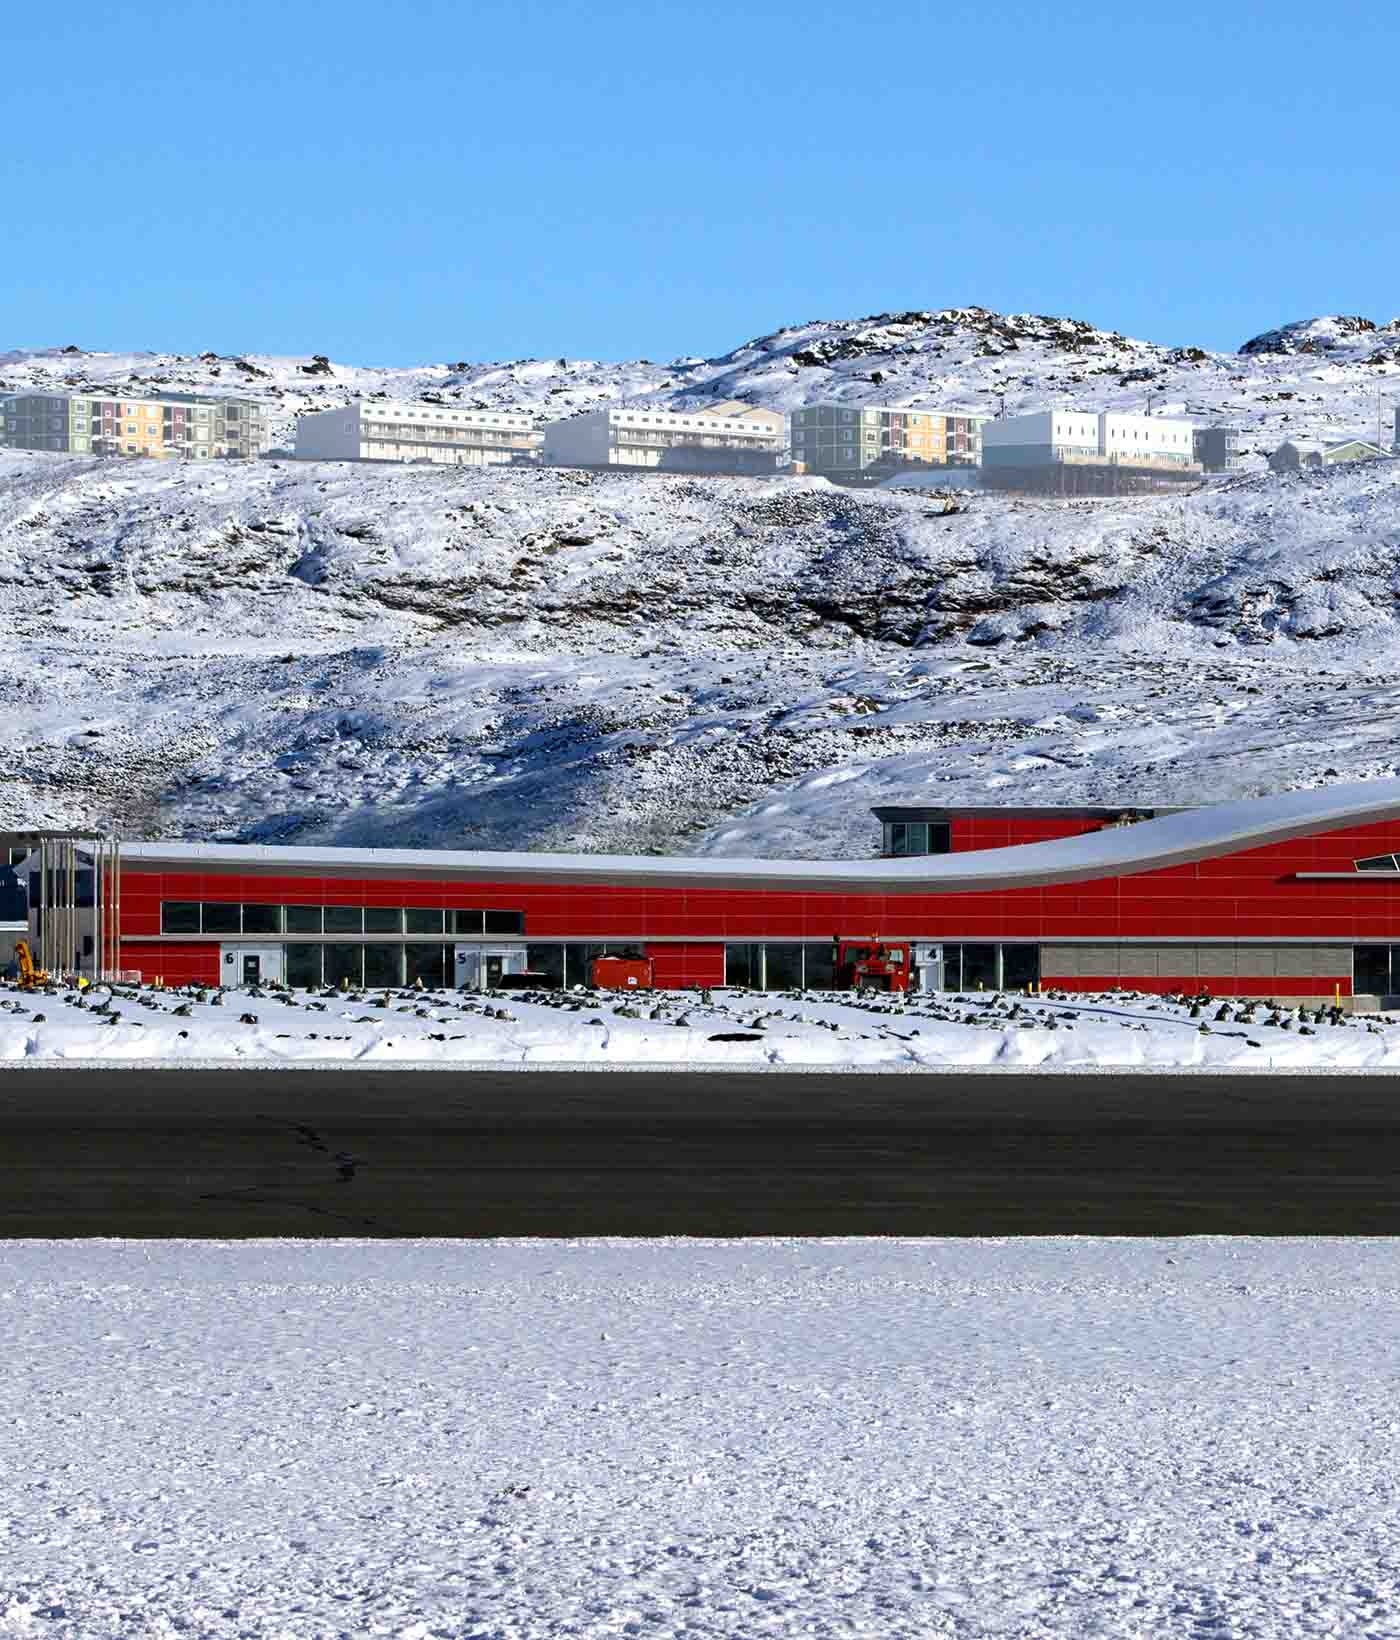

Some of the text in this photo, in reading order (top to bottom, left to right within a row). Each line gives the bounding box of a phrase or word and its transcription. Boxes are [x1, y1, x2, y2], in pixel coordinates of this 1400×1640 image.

[225, 953, 234, 964] 6
[458, 952, 466, 964] 5
[928, 949, 936, 959] 4
